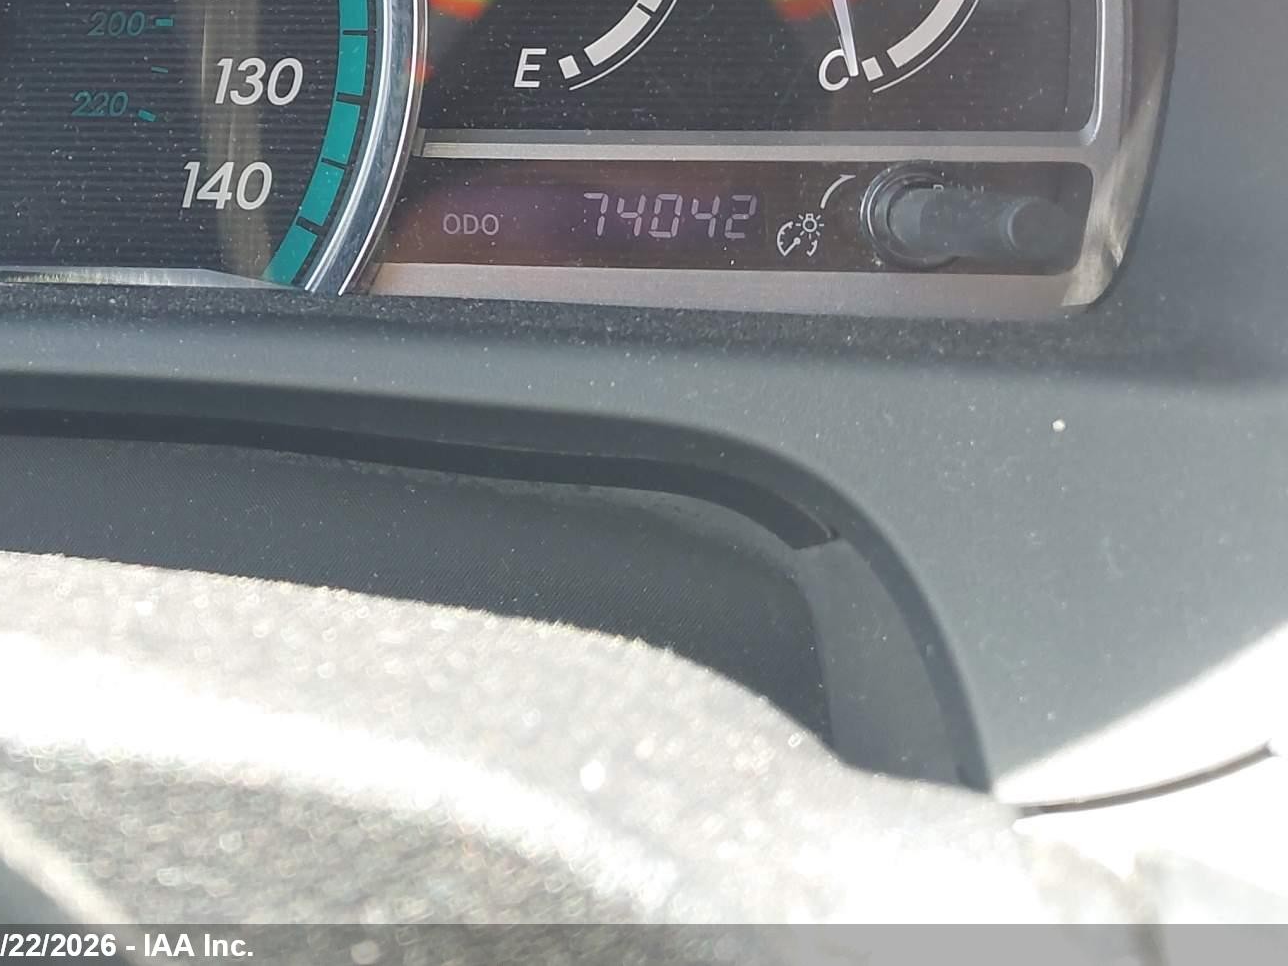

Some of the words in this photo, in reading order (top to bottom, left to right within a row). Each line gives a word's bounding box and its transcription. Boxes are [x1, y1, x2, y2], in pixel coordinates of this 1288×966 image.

[88, 11, 146, 36] 200
[216, 58, 303, 105] 130
[514, 49, 546, 87] E
[819, 52, 849, 90] C
[72, 91, 129, 116] 220
[182, 162, 272, 209] 140
[443, 214, 499, 235] ODO
[583, 192, 757, 239] 74042
